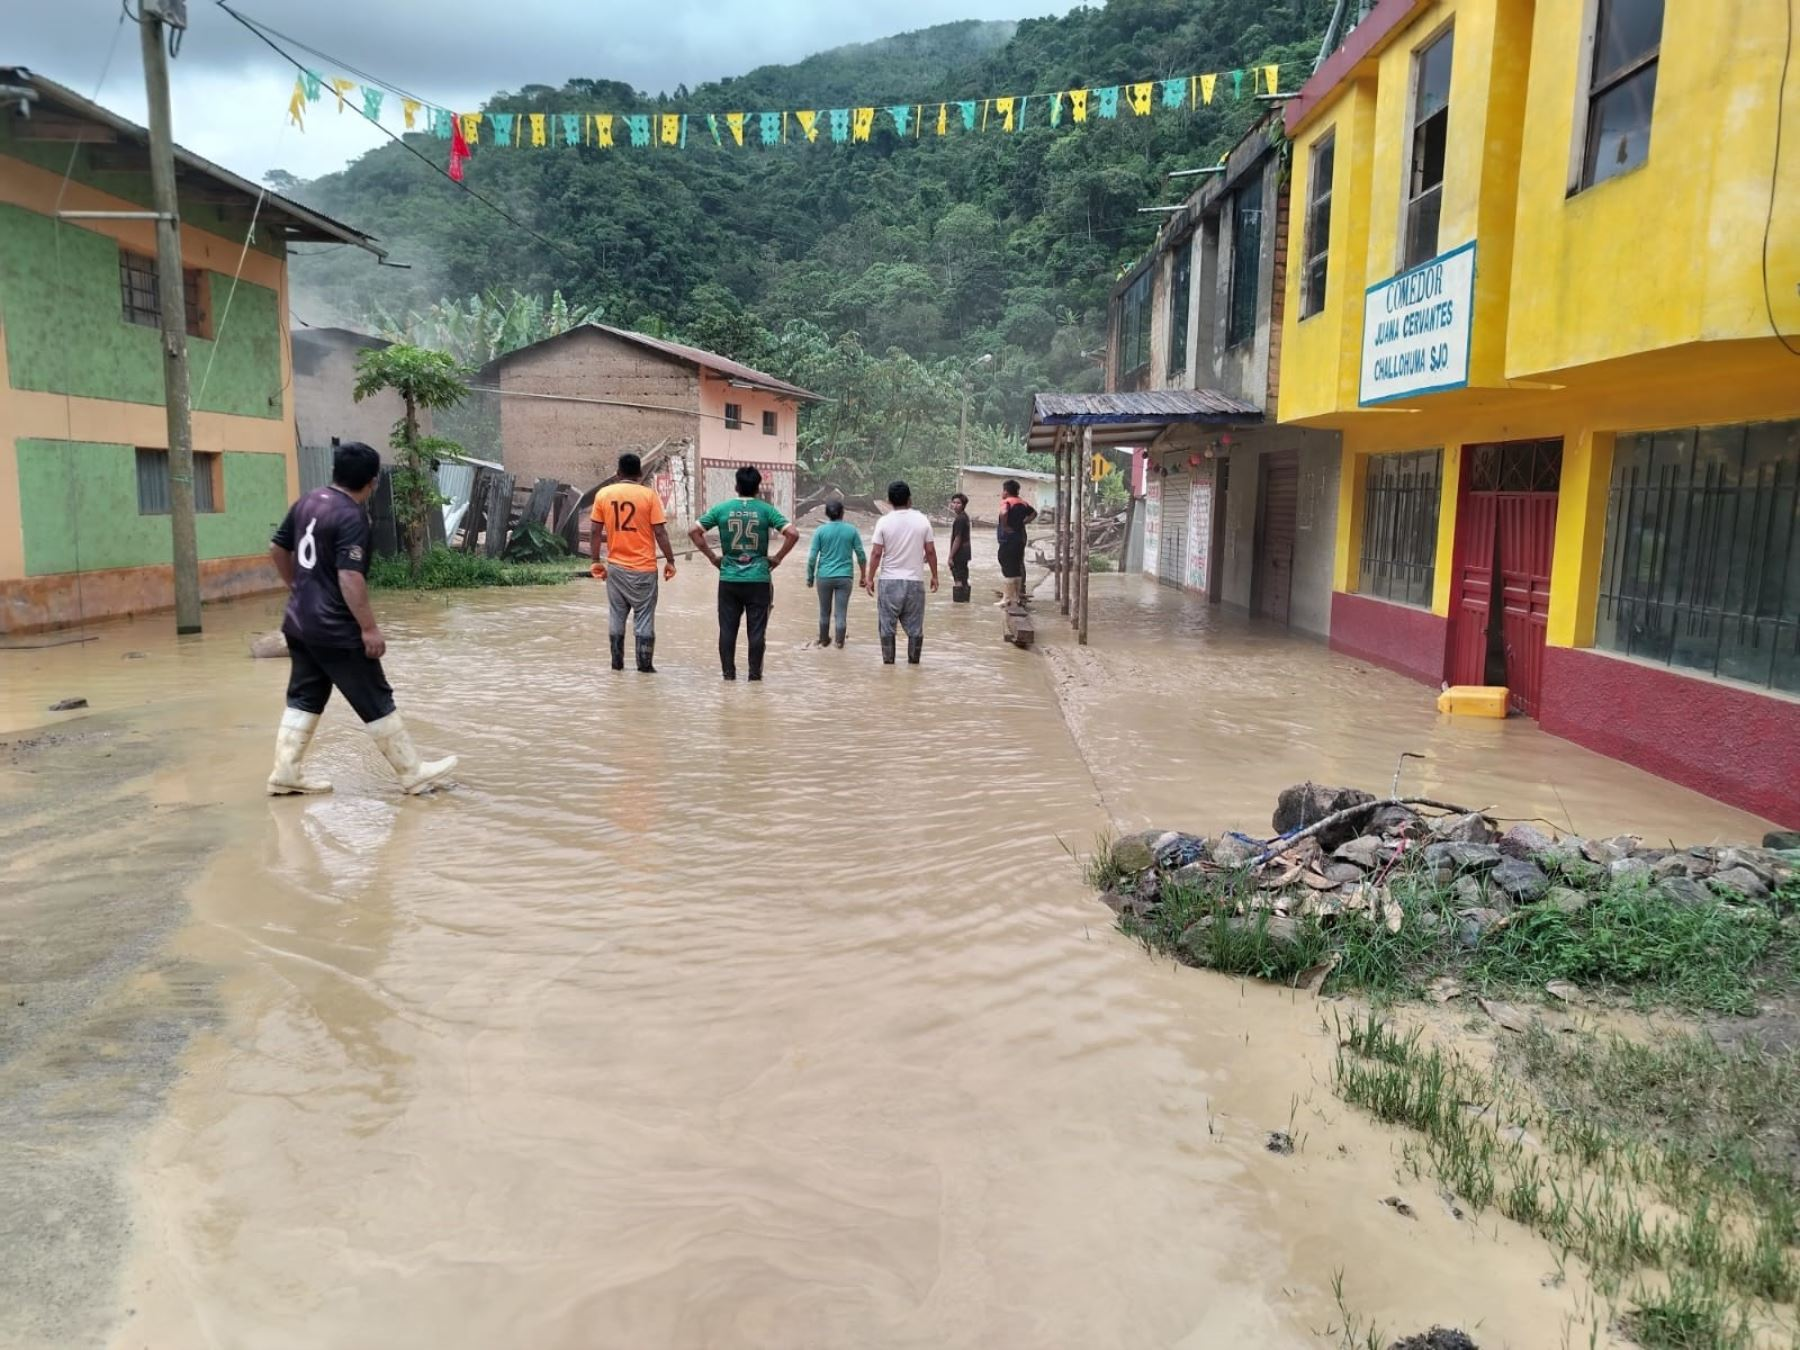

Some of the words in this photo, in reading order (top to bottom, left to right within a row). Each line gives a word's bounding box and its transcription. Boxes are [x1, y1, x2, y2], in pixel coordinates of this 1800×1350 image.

[1386, 263, 1443, 314] COMEDOR
[1374, 317, 1399, 346] JUANA
[1402, 299, 1453, 338] CERVANTES
[1374, 347, 1425, 381] CHALLOHUMA
[610, 500, 637, 533] 12
[728, 518, 760, 550] 25
[298, 517, 317, 569] 6
